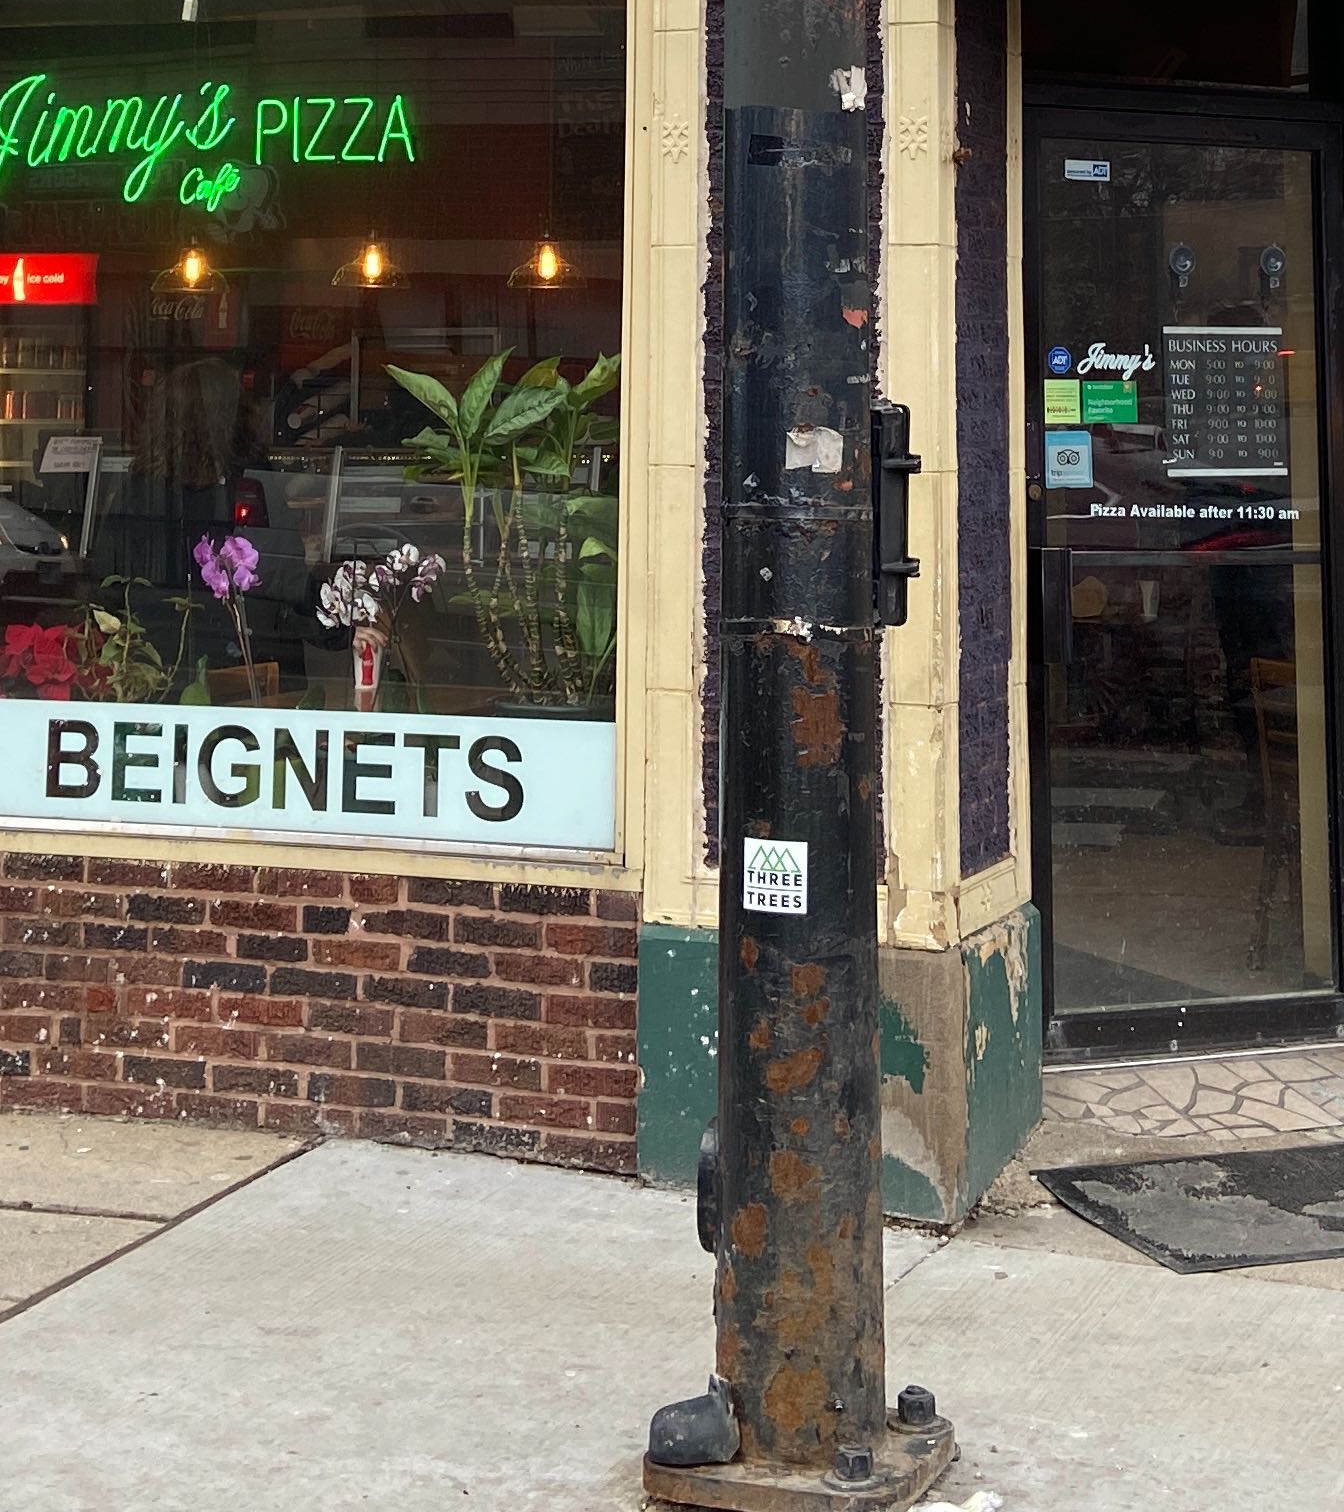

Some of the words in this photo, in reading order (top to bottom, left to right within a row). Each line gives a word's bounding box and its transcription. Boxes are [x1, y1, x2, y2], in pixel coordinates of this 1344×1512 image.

[256, 95, 416, 165] PIZZA
[27, 274, 41, 284] ice
[42, 273, 64, 284] cold
[1168, 339, 1226, 353] BUSINESS
[1231, 340, 1278, 353] HOURS
[1052, 355, 1068, 365] ADT
[1077, 342, 1156, 381] Jimmy's
[1170, 359, 1195, 370] MON
[1171, 374, 1190, 385] TUE
[1171, 389, 1196, 400] WED
[1172, 404, 1194, 414] THU
[1172, 419, 1187, 429] FRI
[1172, 434, 1190, 444] SAT
[1173, 449, 1195, 459] SUN
[1090, 504, 1125, 517] Pizza
[1130, 504, 1195, 518] Available
[1199, 506, 1233, 519] after
[1237, 506, 1274, 519] 11:30
[1278, 510, 1300, 520] am
[45, 718, 524, 823] BEIGNETS
[747, 870, 802, 886] THREE
[747, 891, 802, 908] TREES
